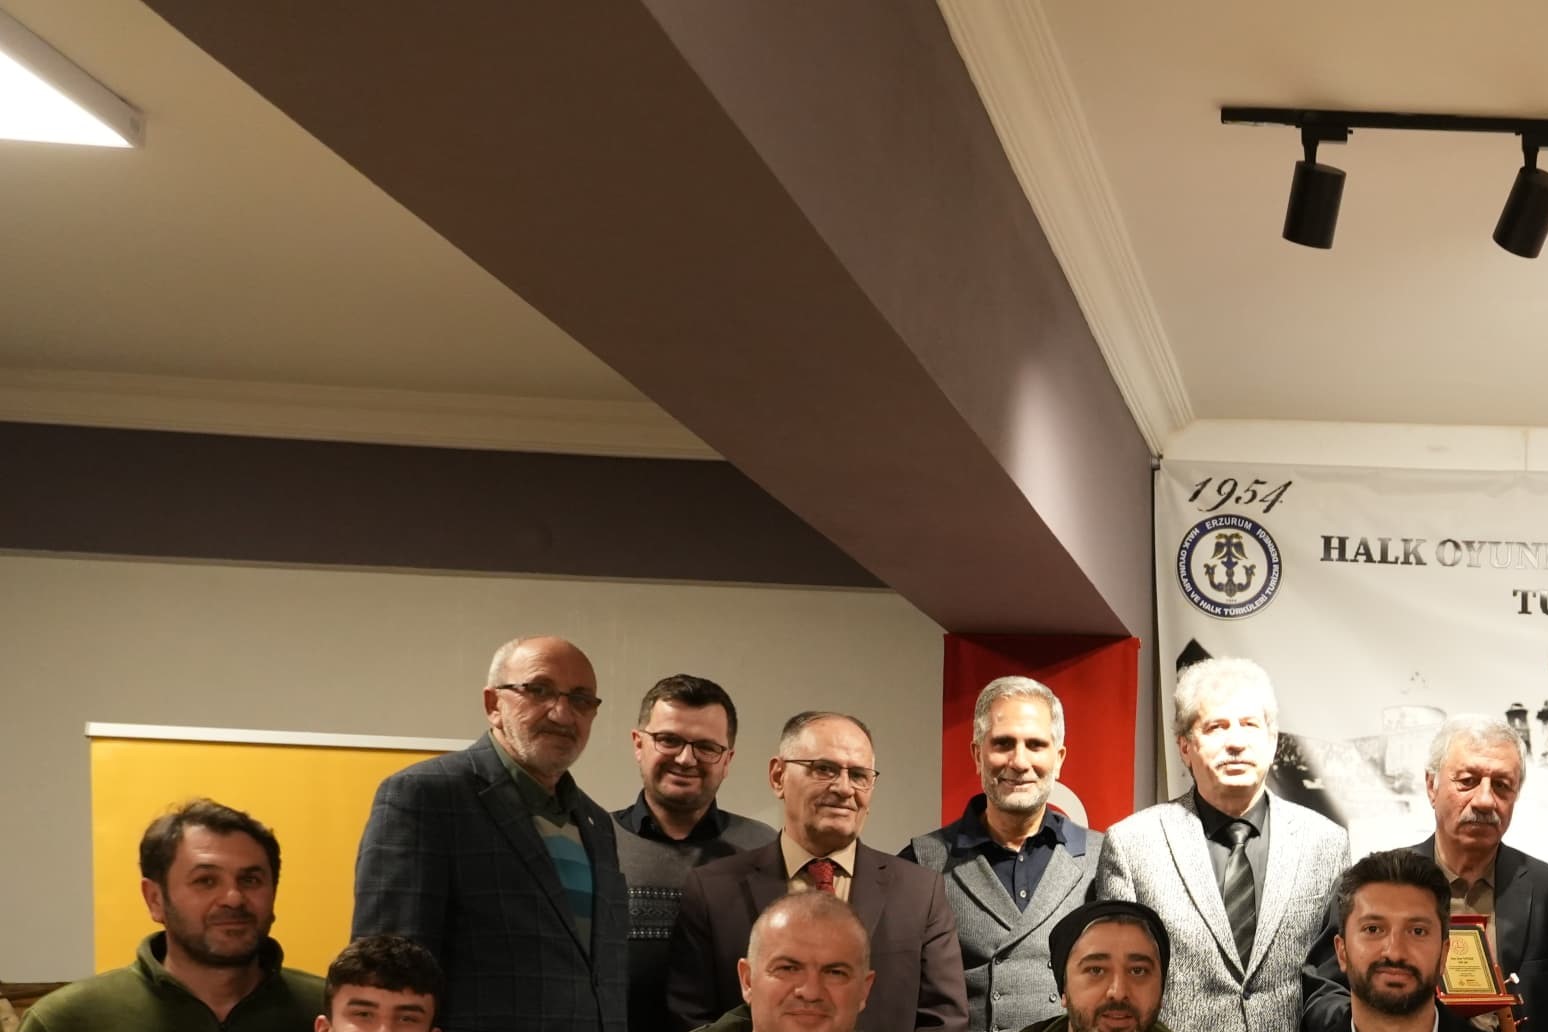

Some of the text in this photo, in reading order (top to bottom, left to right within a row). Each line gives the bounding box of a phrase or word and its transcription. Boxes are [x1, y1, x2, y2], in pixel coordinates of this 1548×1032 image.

[1188, 477, 1292, 513] 1954
[1205, 517, 1252, 530] ERZURUM
[1320, 535, 1427, 565] HALK
[1183, 527, 1200, 550] HALK
[1199, 600, 1222, 615] HALK
